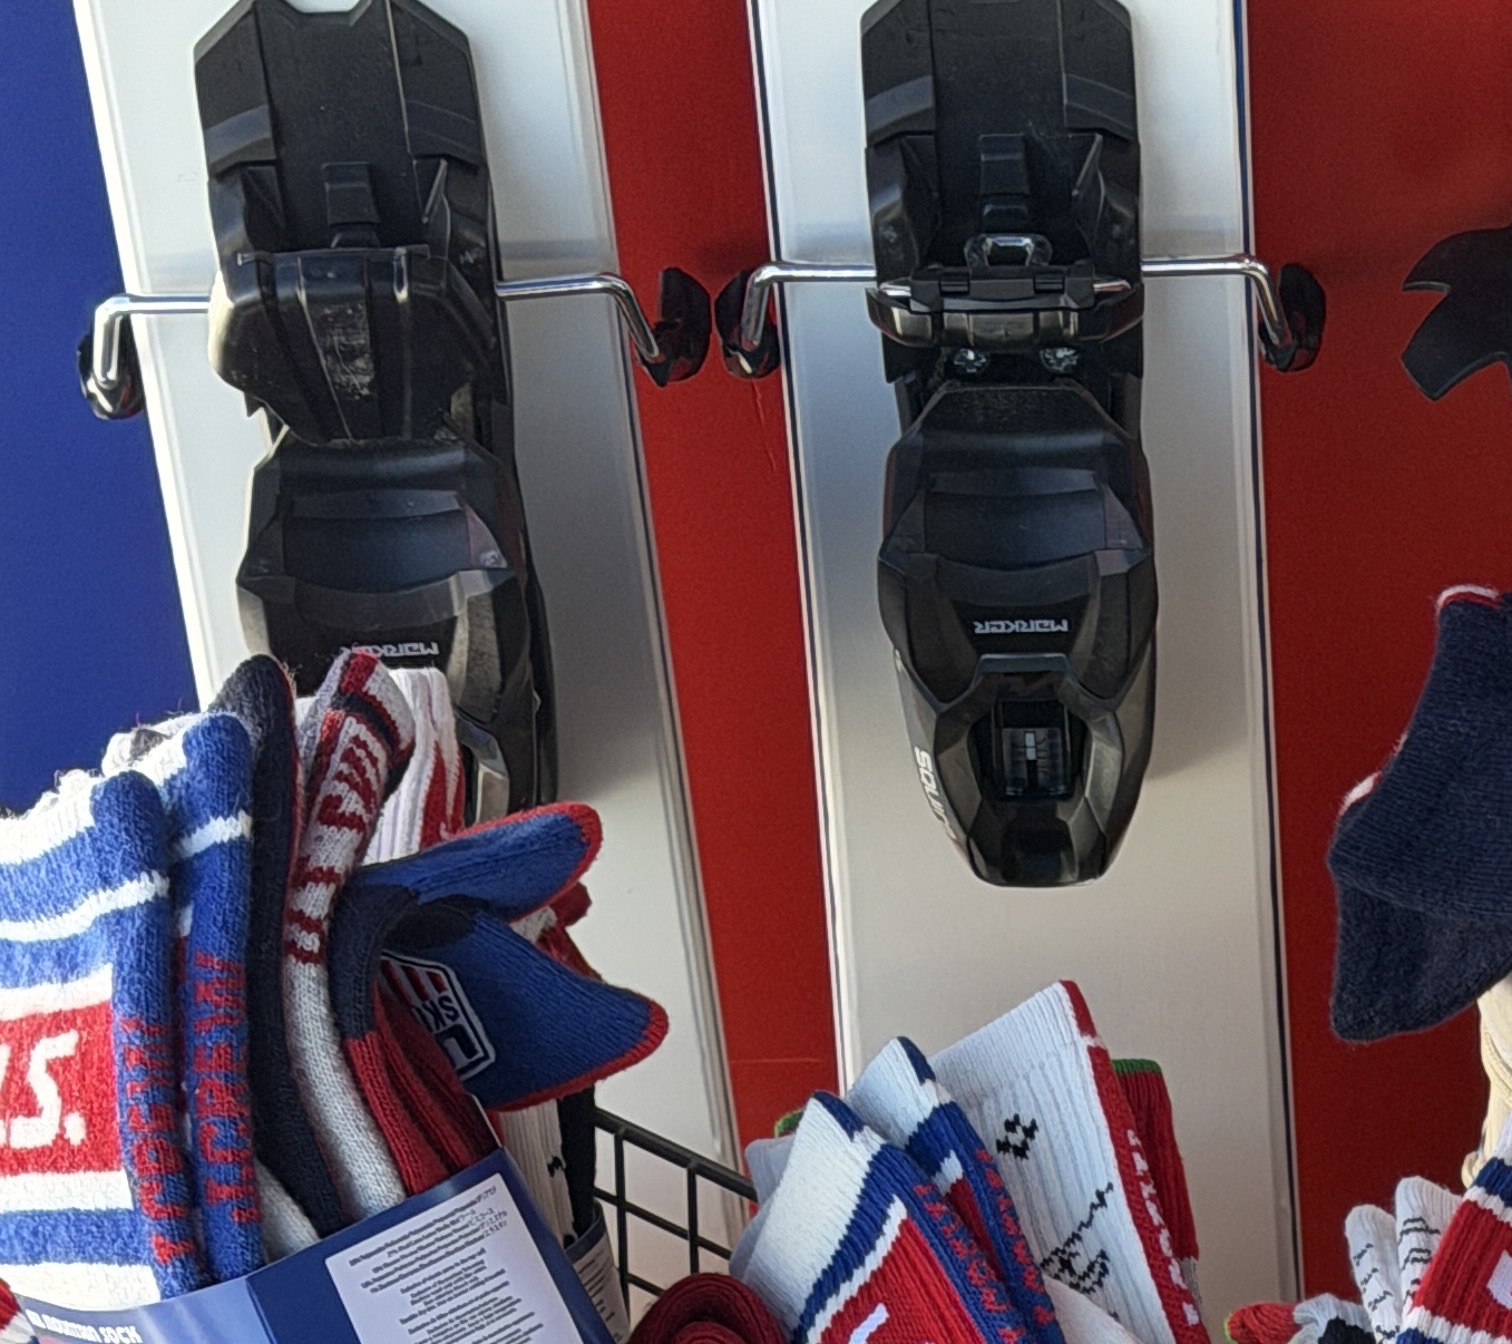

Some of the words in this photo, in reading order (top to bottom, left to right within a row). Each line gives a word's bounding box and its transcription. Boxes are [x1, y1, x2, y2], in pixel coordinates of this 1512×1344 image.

[973, 619, 1069, 634] MARKER
[341, 641, 440, 658] MARK
[0, 1027, 86, 1149] S.
[122, 1016, 196, 1266] JCREW
[98, 1325, 144, 1344] SOCK
